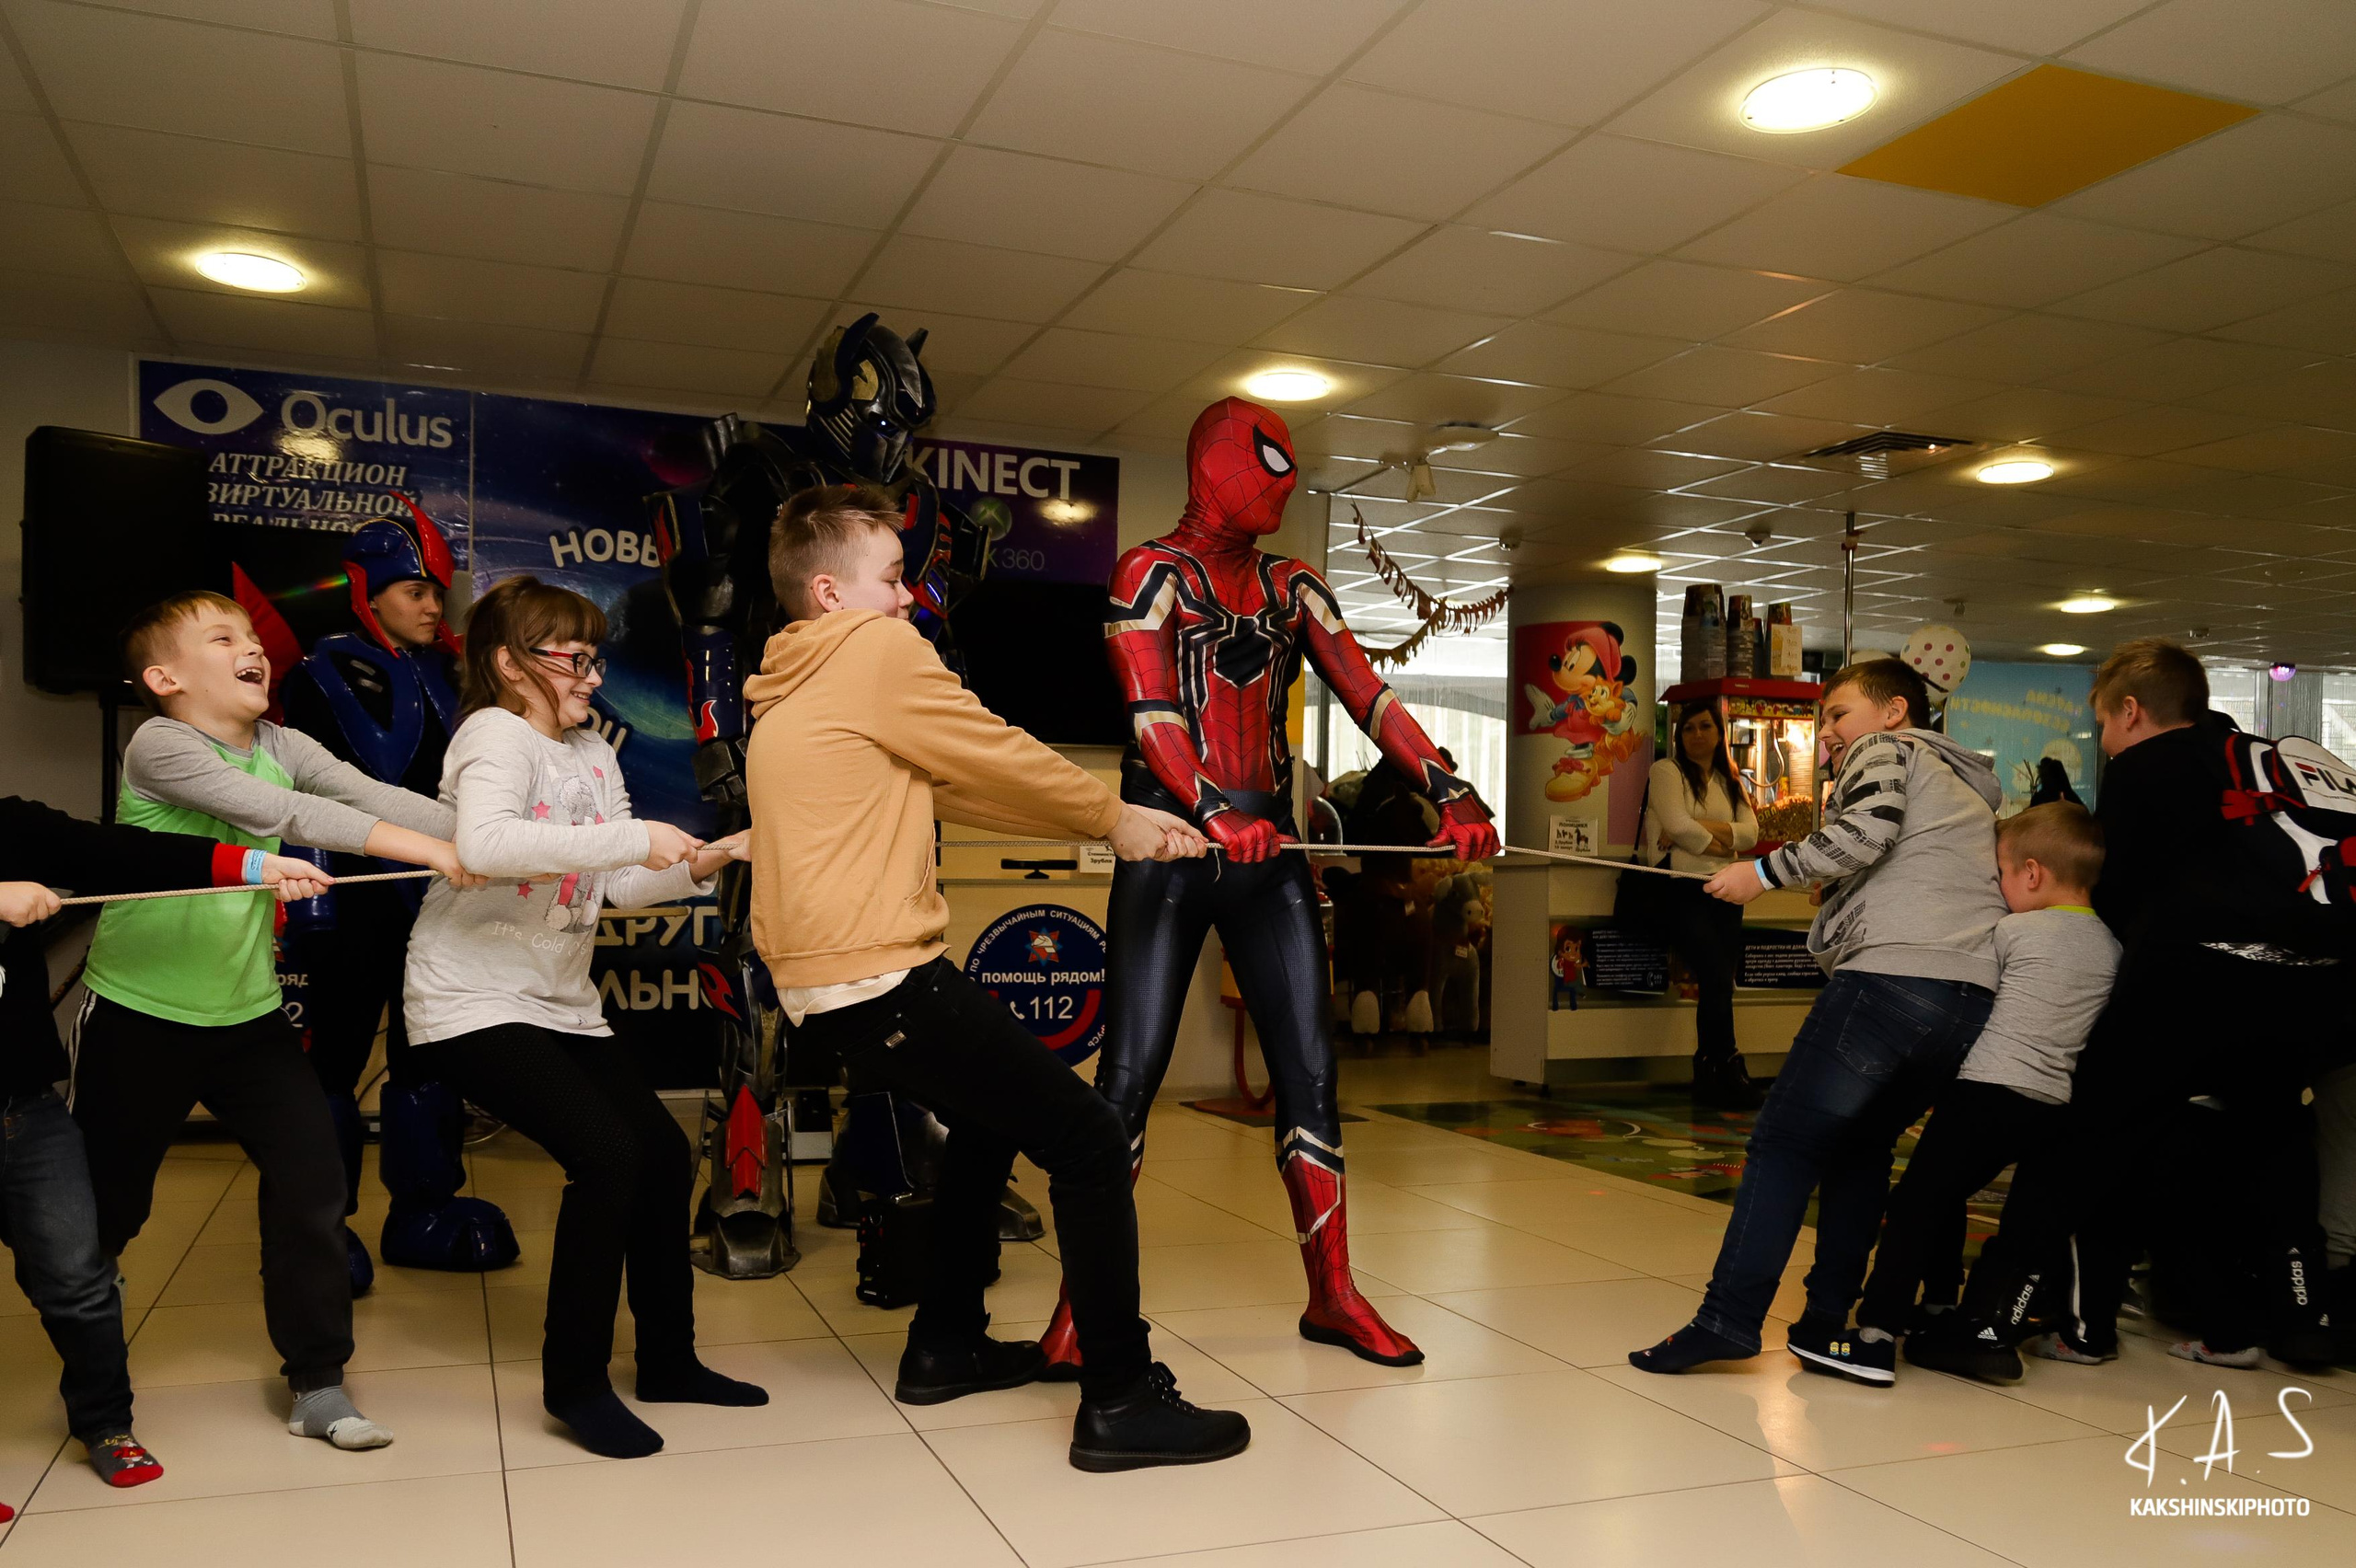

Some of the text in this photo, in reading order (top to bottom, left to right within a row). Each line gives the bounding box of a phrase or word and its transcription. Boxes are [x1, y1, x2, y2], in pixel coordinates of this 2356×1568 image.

[281, 393, 454, 449] Oculus
[208, 452, 408, 487] АТТРАКЦИОН
[904, 445, 1080, 501] KINECT
[1001, 549, 1045, 571] 360
[491, 921, 523, 940] It's
[531, 932, 566, 953] Cold
[969, 958, 981, 973] ПО
[976, 909, 1045, 955] ЧРЕЗВЫЧАЙНЫМ
[1049, 909, 1101, 940] СИТУАЦИЯМ
[598, 969, 714, 1010] ЛЬН
[981, 969, 1106, 986] помощь рядом!
[1029, 996, 1074, 1020] 112
[2290, 1260, 2309, 1306] adidas
[2010, 1284, 2034, 1326] adidas
